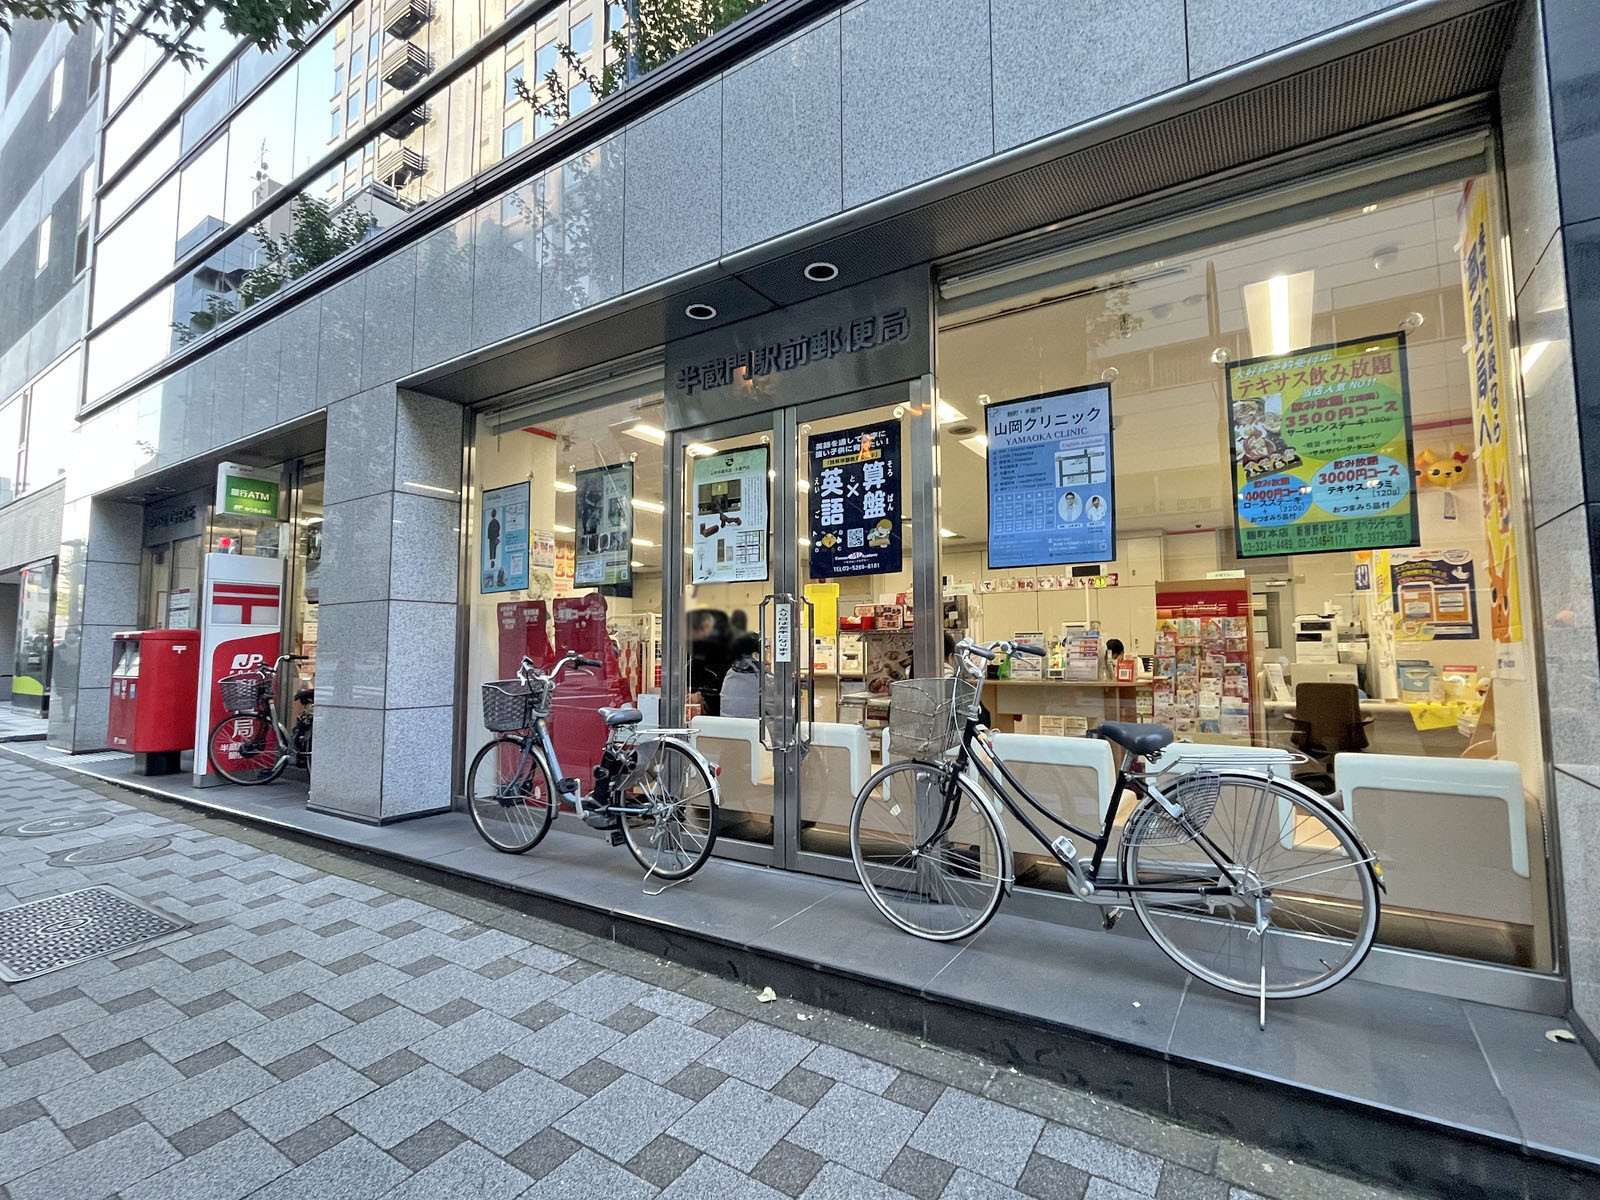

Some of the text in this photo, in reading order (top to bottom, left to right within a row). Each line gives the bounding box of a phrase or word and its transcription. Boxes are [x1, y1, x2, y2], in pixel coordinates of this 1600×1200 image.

[676, 307, 909, 395] 半蔵門駅前郵便局
[1238, 353, 1393, 398] テキサス飲み放題
[994, 407, 1100, 437] 山岡クリニック
[1285, 400, 1398, 428] 3500円コース
[1006, 427, 1088, 446] YAMAOKA CLINIC
[1318, 464, 1400, 485] 3000円コース
[1333, 456, 1379, 470] 飲み放題
[820, 467, 844, 526] 英語
[862, 461, 887, 519] 算盤
[1333, 501, 1390, 514] おつまみ5品付
